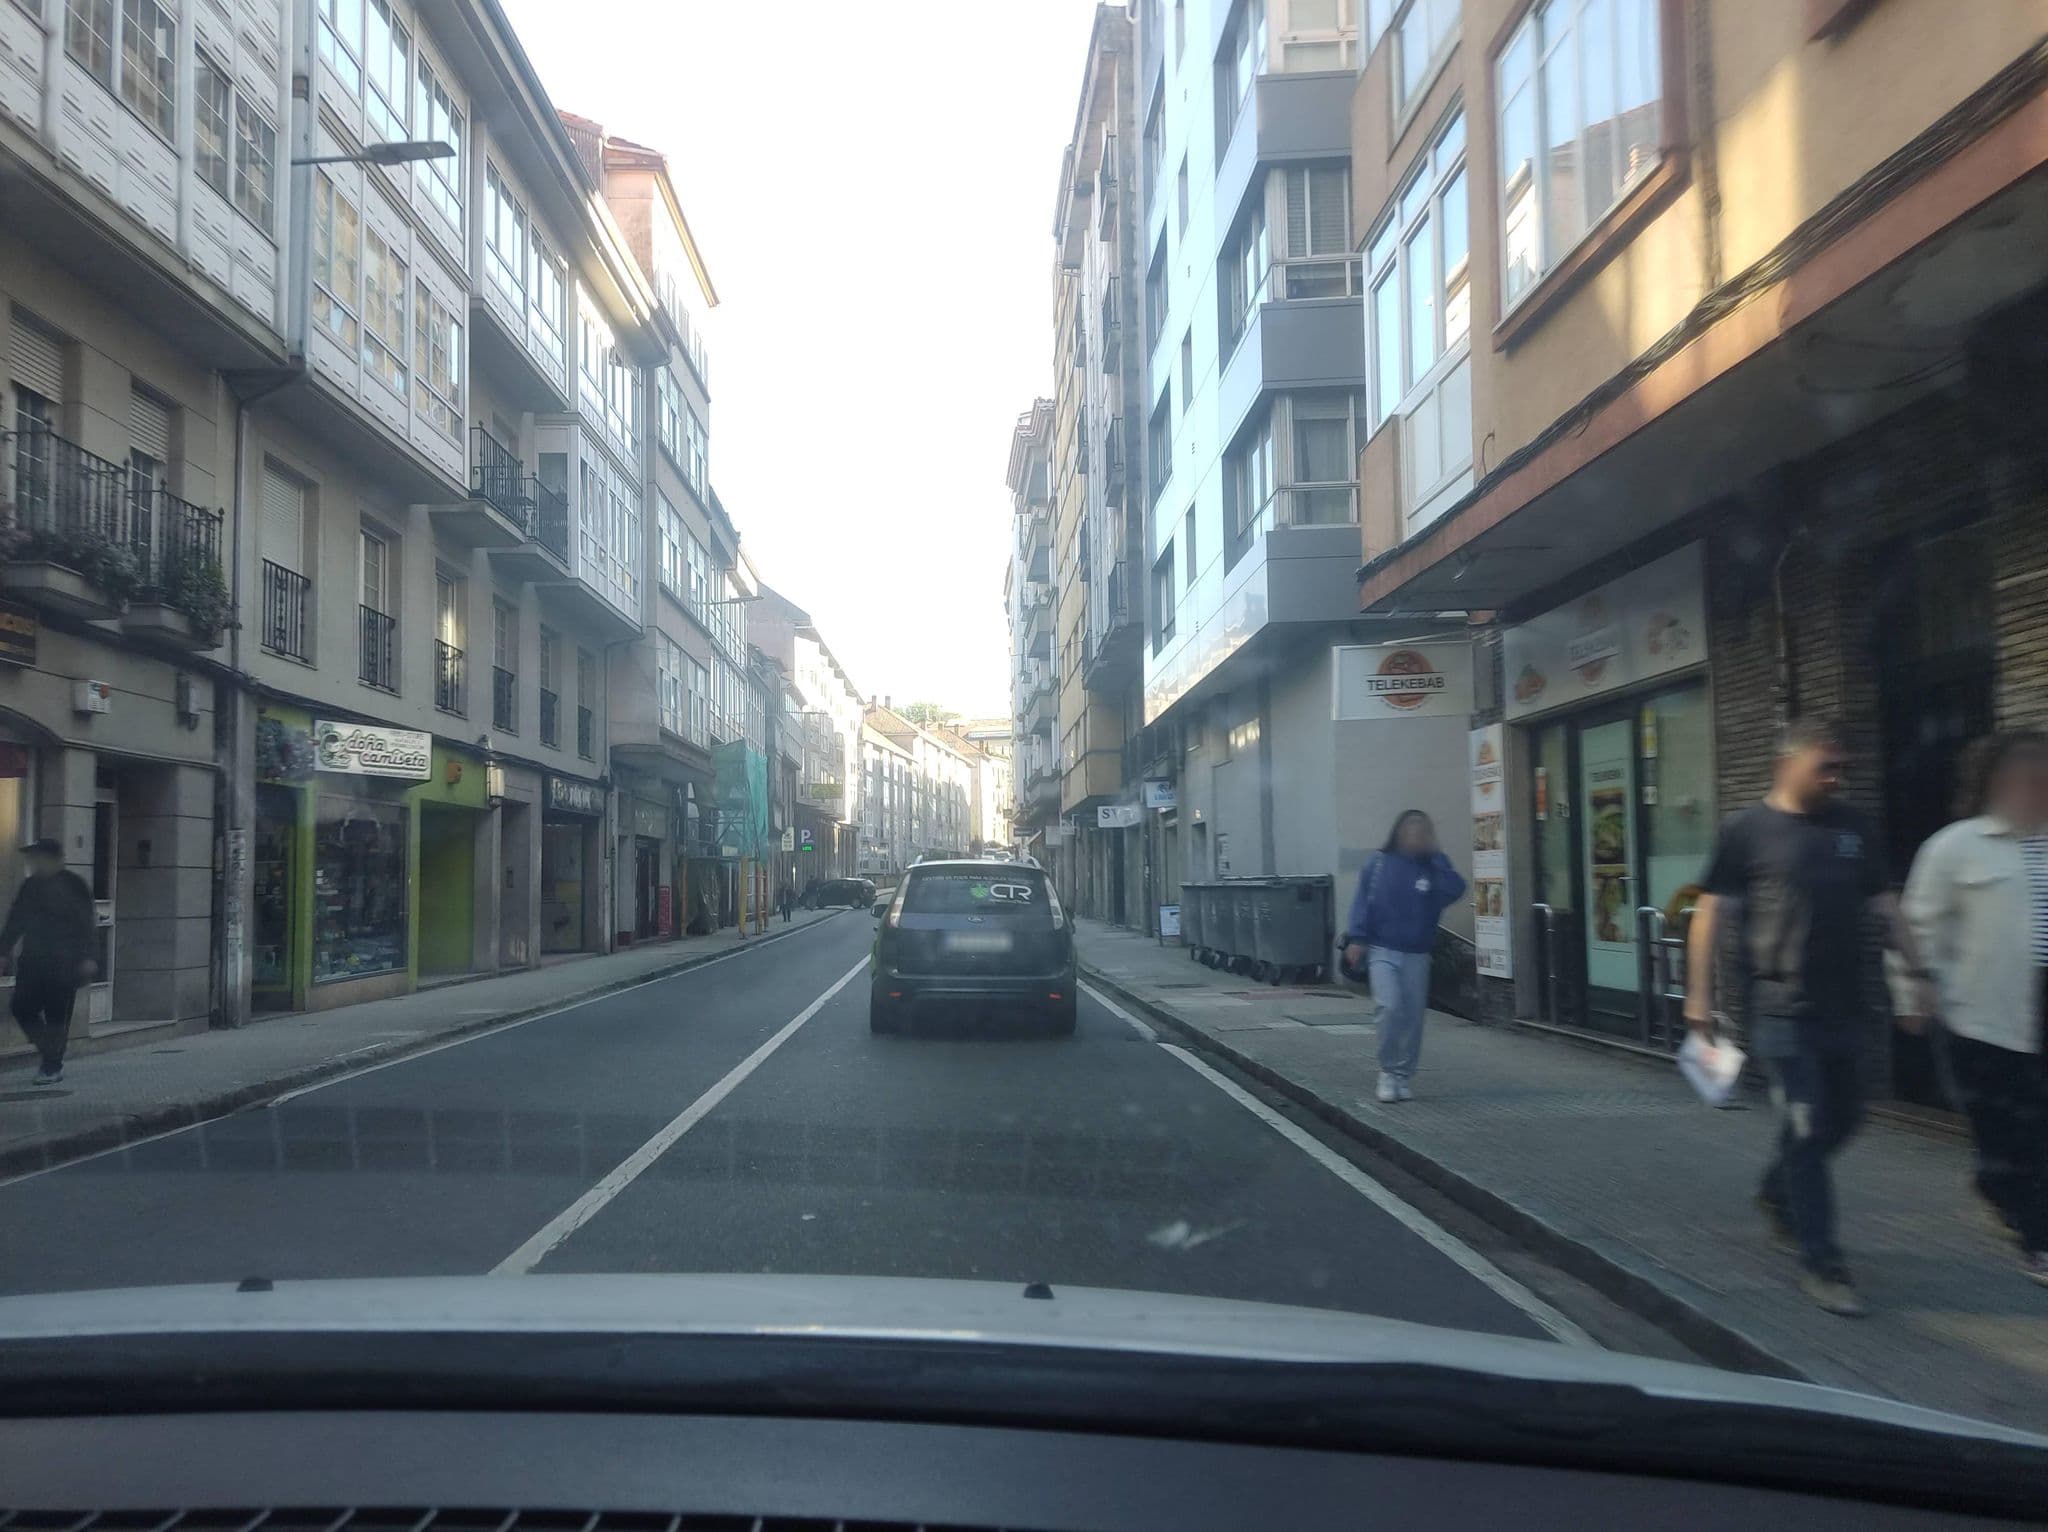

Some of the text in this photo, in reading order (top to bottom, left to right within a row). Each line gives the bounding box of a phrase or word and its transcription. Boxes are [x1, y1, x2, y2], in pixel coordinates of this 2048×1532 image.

[1367, 677, 1445, 691] TELEKEBAB
[346, 731, 385, 752] doña
[361, 751, 427, 767] camiseta
[800, 829, 811, 843] P
[990, 883, 1032, 900] CTR
